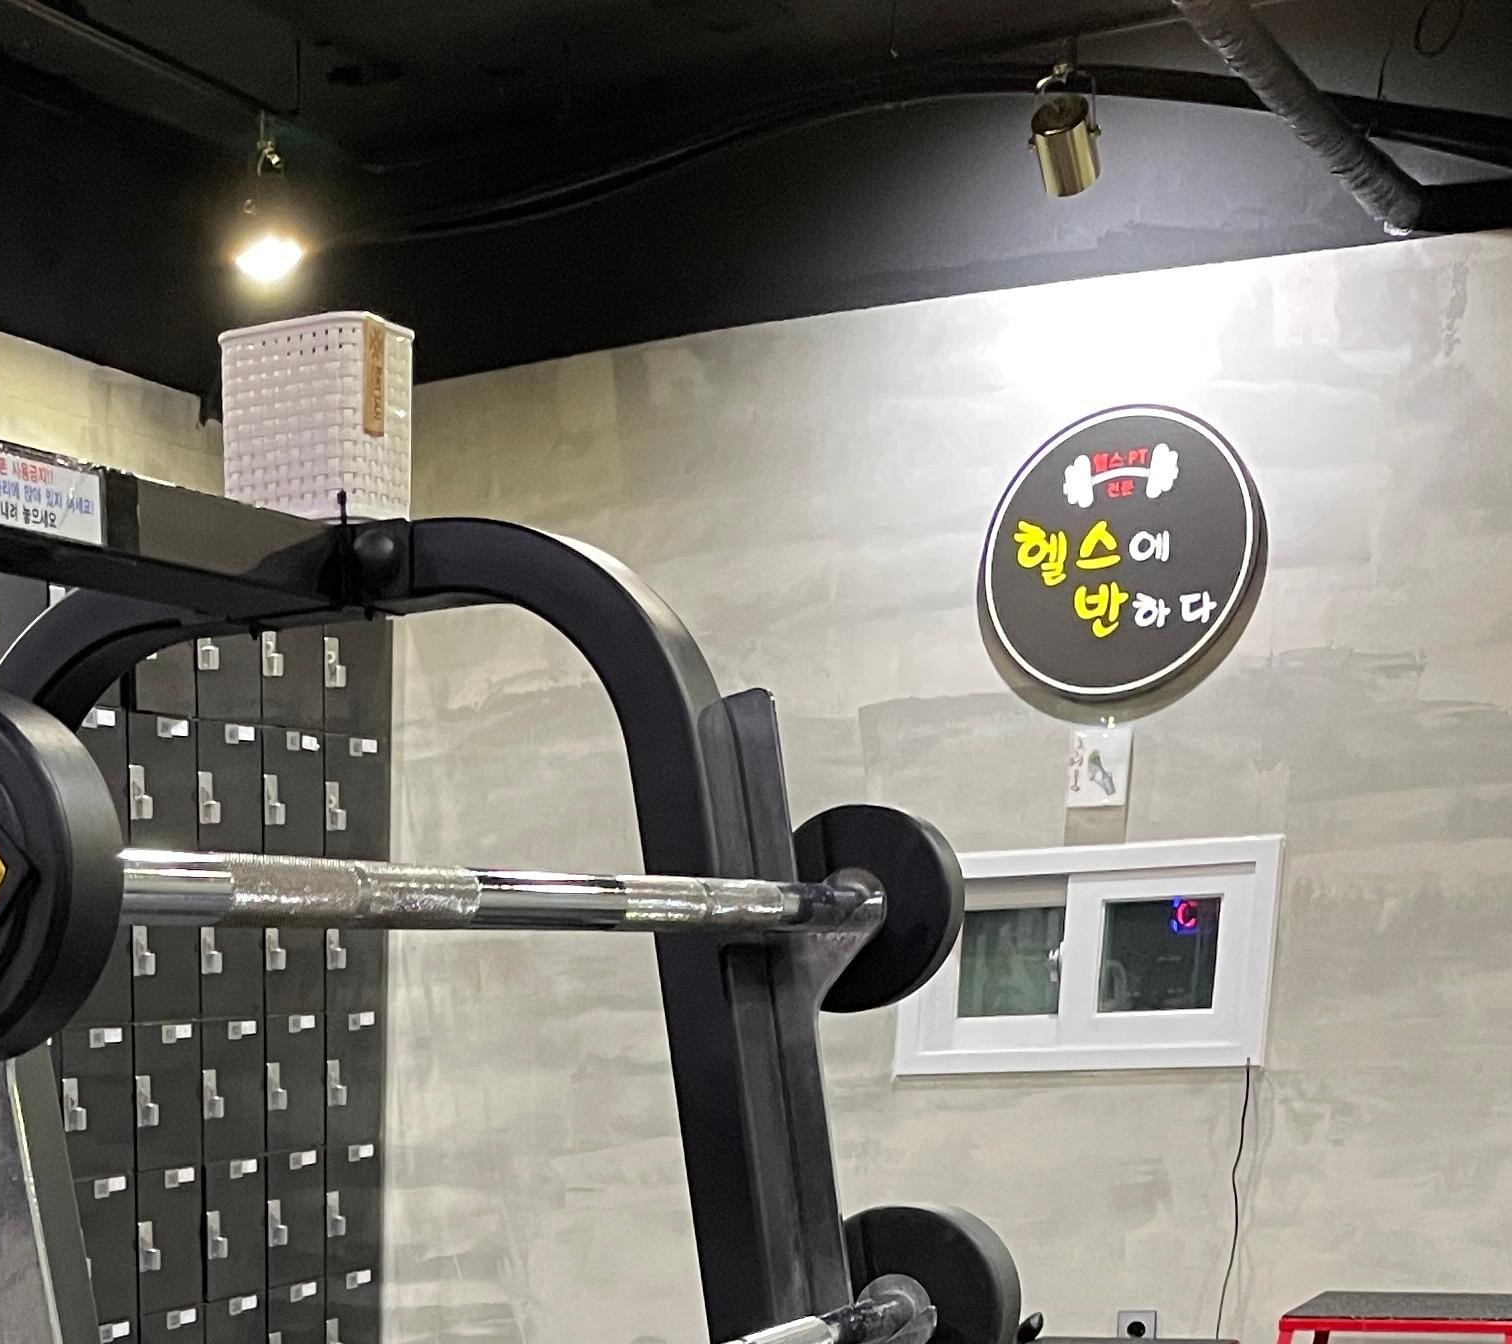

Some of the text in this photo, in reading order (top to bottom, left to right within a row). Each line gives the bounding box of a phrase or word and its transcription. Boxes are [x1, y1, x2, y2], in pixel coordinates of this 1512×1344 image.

[1127, 448, 1149, 466] PT
[1012, 519, 1171, 587] 헬스에
[1073, 580, 1218, 639] 반하다
